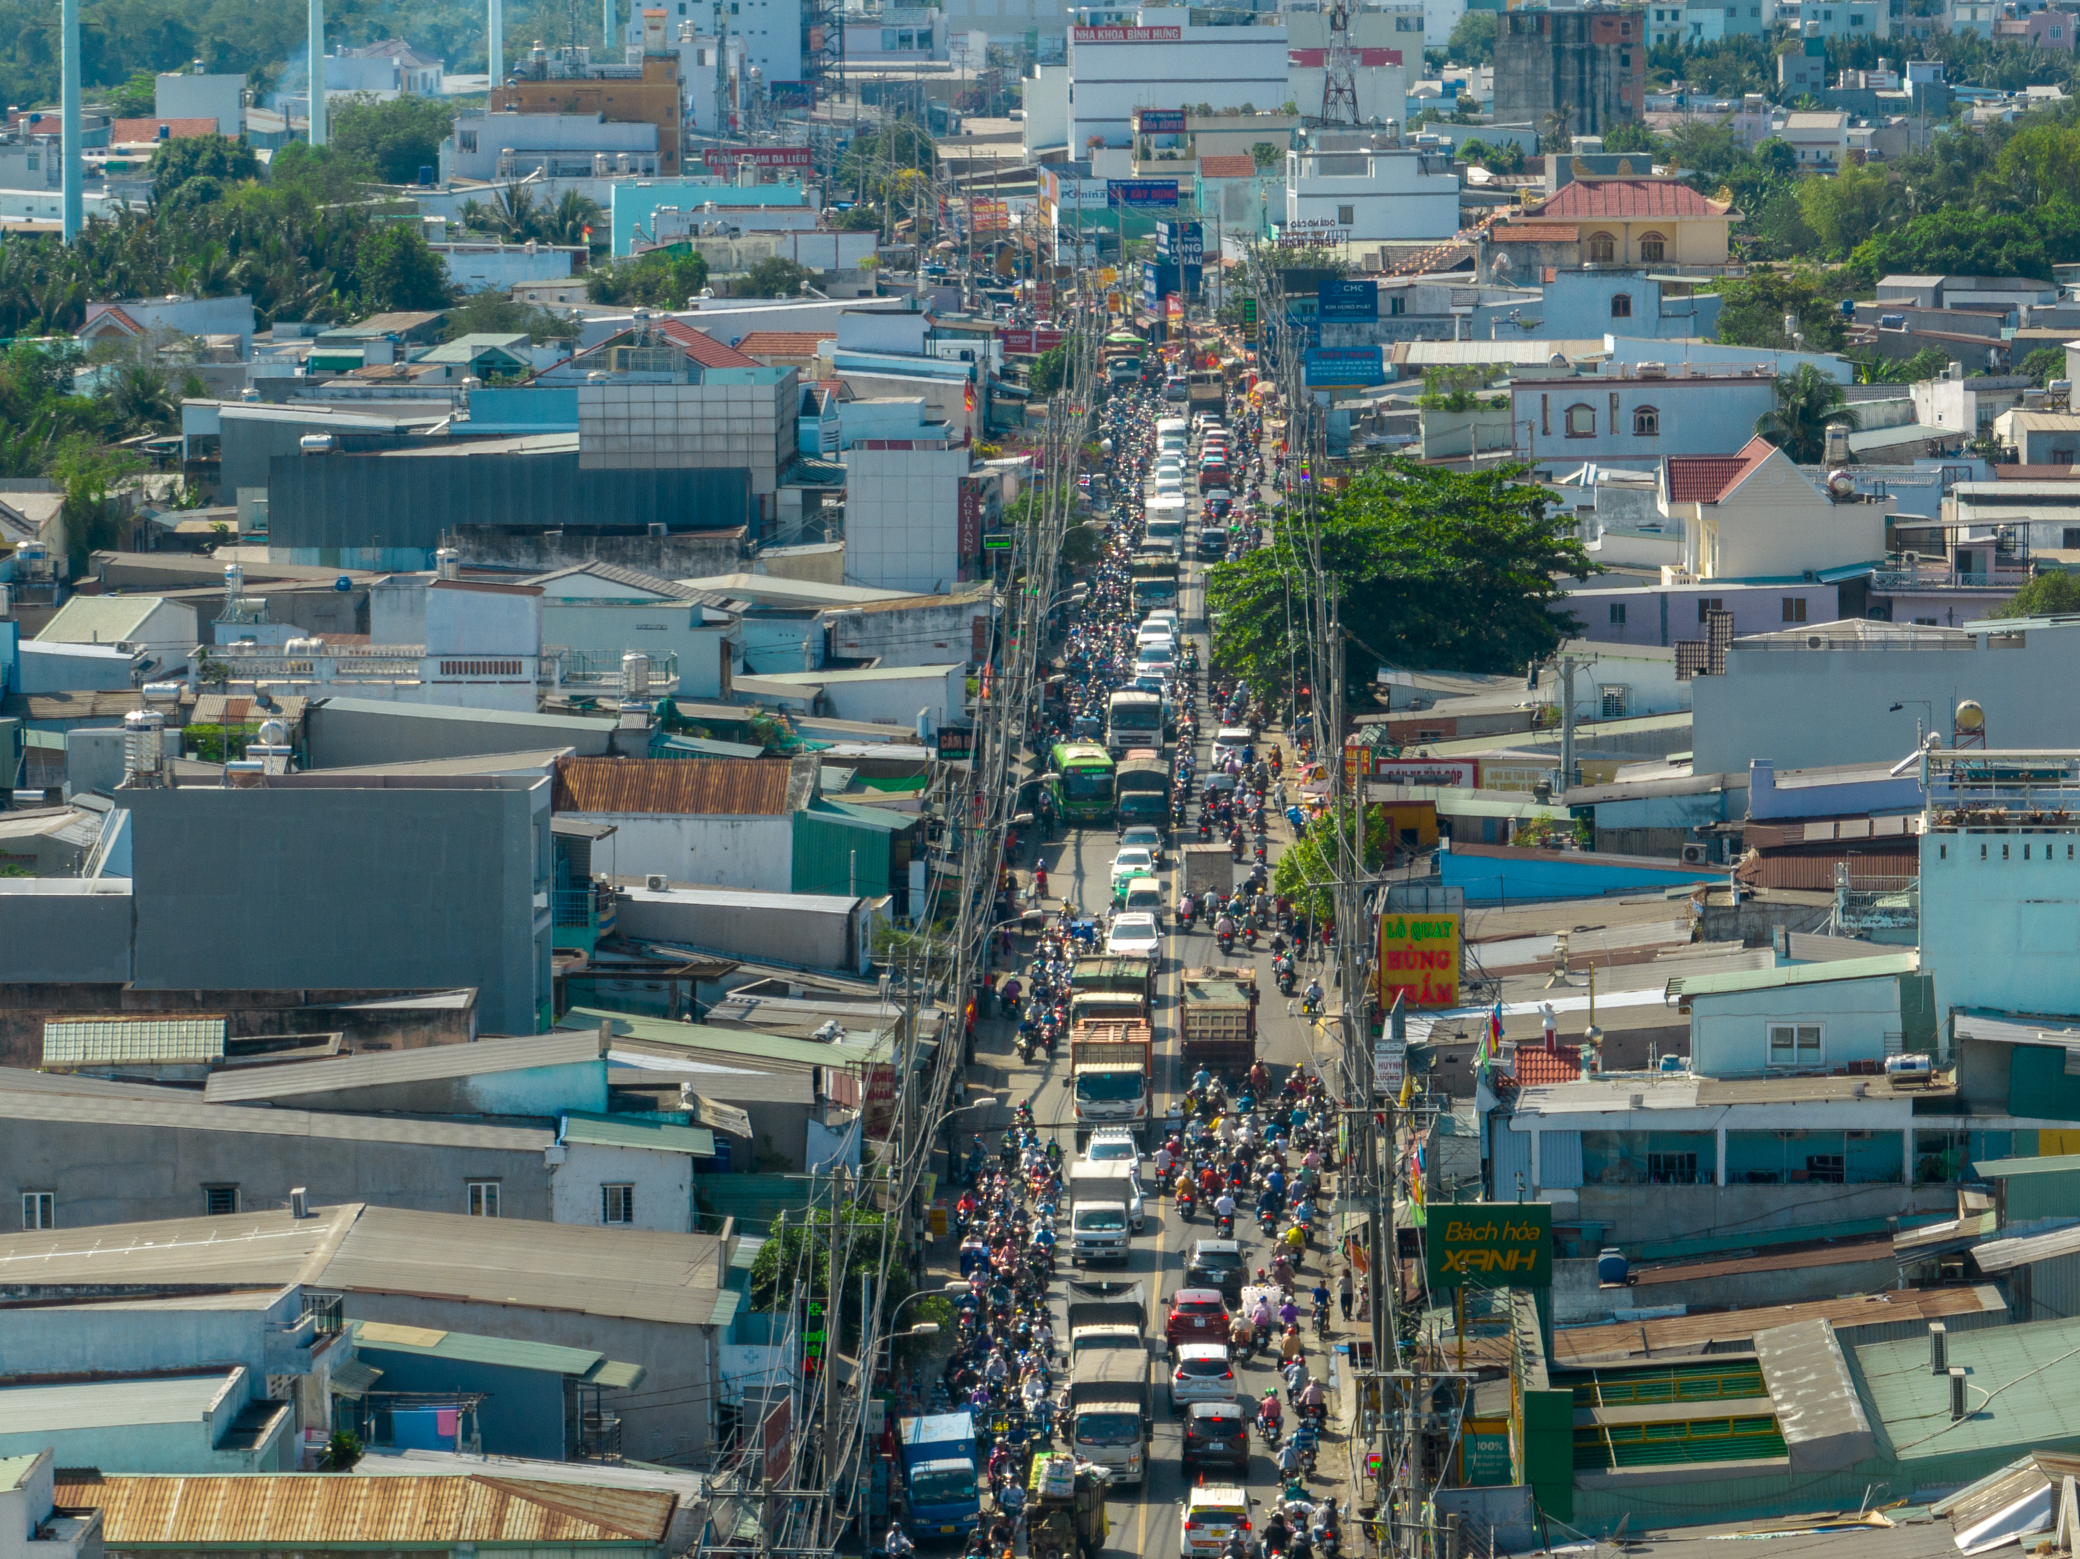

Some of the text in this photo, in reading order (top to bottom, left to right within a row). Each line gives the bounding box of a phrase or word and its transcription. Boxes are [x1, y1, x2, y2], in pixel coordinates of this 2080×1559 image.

[1075, 30, 1096, 40] NHA
[1097, 30, 1124, 40] KHOA
[1170, 243, 1202, 253] LONG
[1343, 284, 1364, 292] CMC
[963, 495, 974, 552] AGRIBANK
[1410, 921, 1453, 942] QUAY
[1386, 944, 1452, 971] HÙNG
[1445, 1220, 1541, 1242] Bách hóa
[1440, 1249, 1537, 1272] XANH
[1475, 1441, 1504, 1451] 100%
